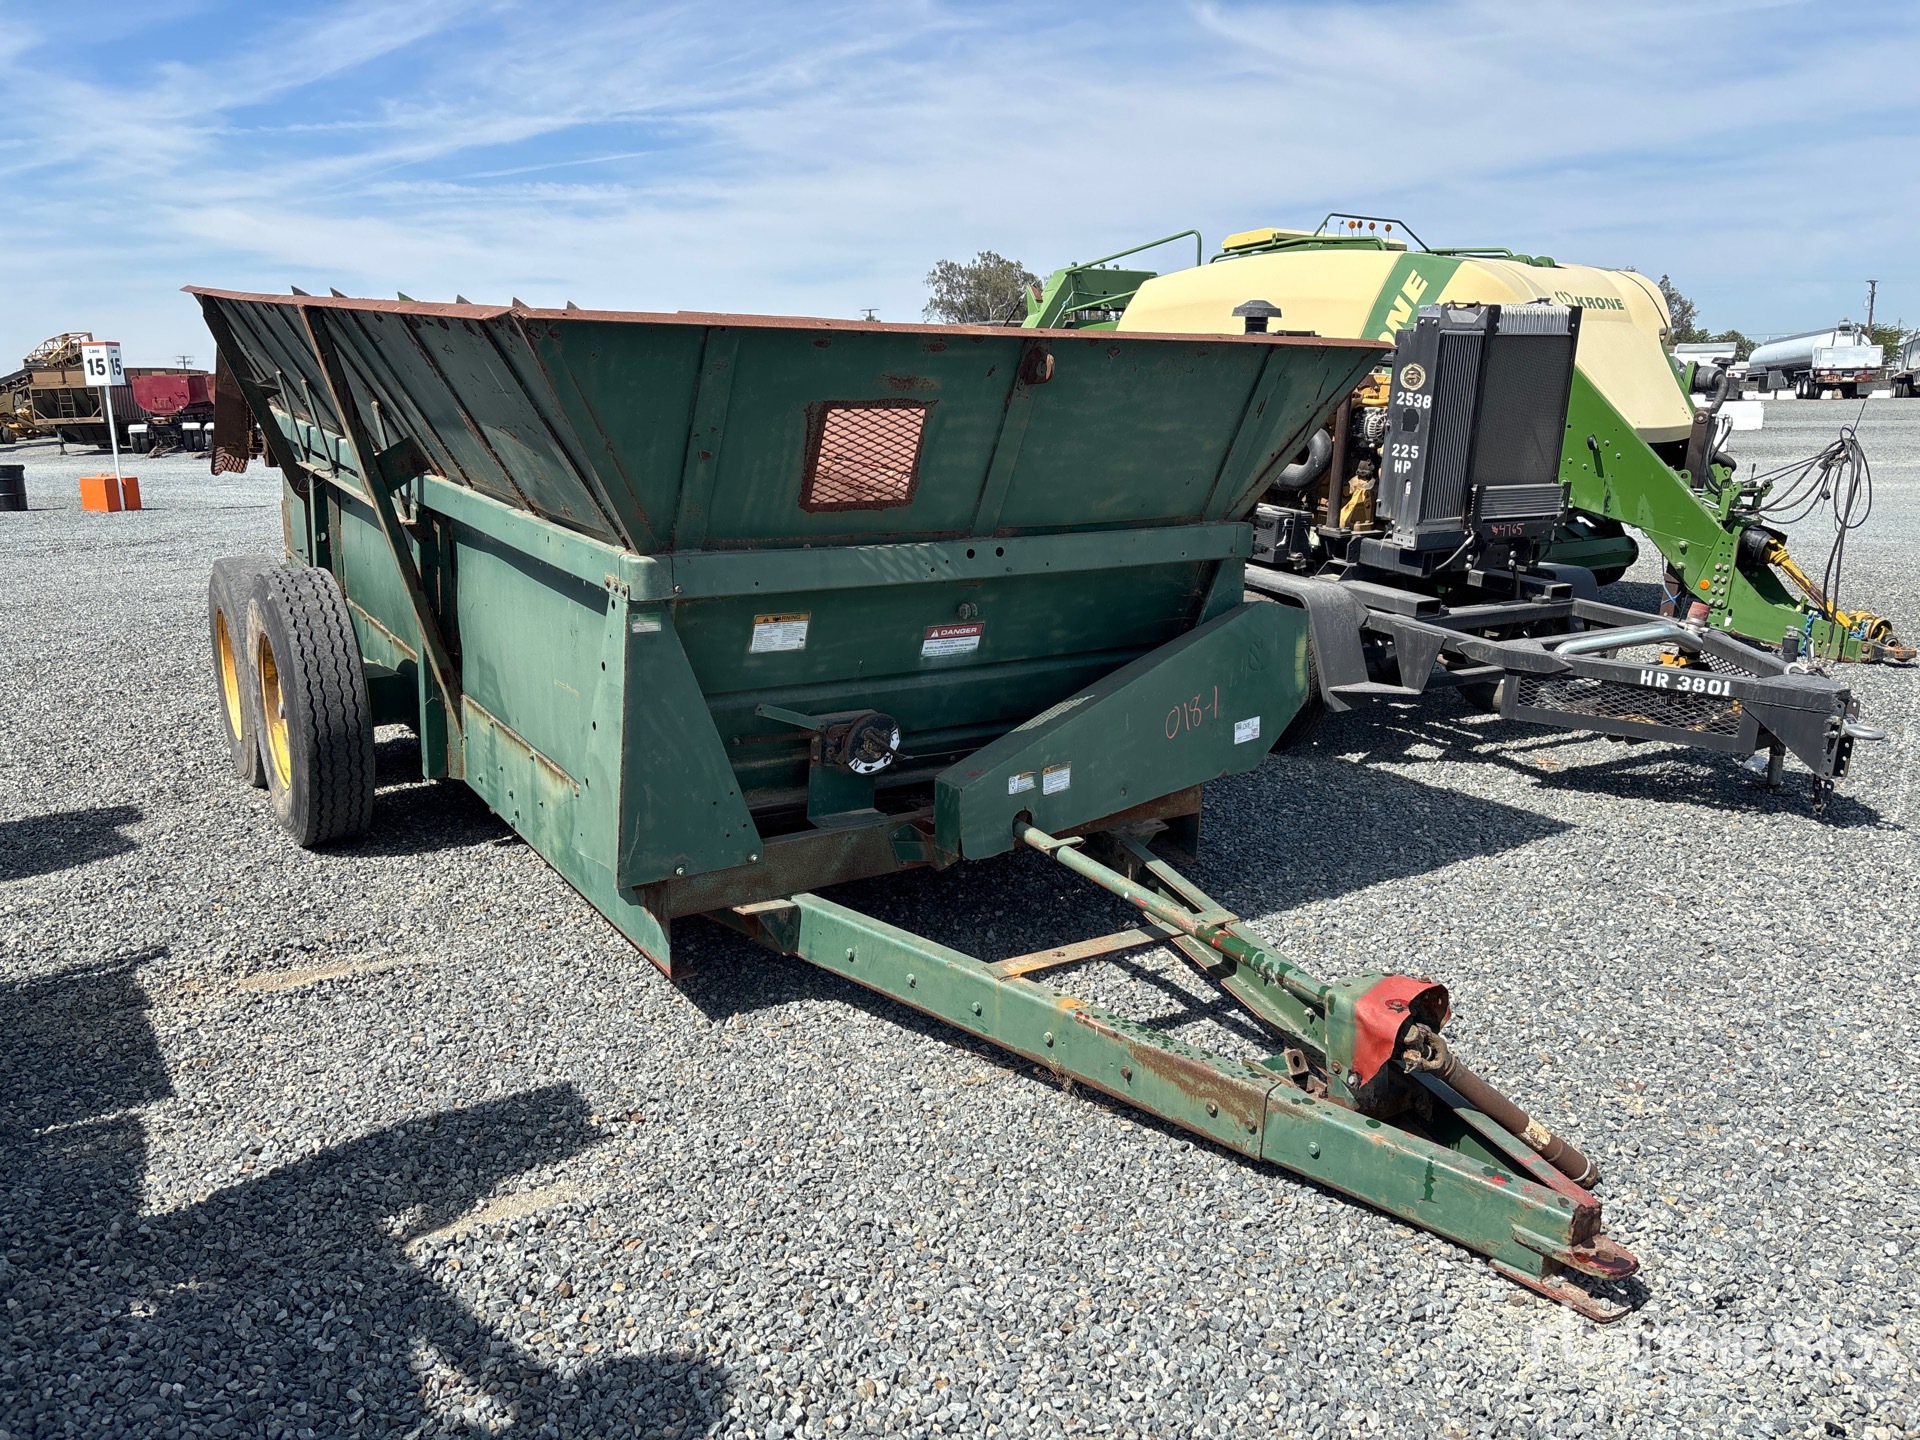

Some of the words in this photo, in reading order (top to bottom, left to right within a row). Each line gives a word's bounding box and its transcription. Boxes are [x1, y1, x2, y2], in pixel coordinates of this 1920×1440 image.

[1574, 296, 1625, 310] KRONE
[87, 357, 106, 376] 15
[110, 357, 122, 376] 15
[1396, 391, 1432, 409] 2538
[1391, 443, 1419, 459] 225
[1394, 459, 1412, 474] HP
[940, 627, 978, 636] DANGER
[1640, 669, 1669, 688] HR
[1676, 675, 1731, 697] 3801
[1165, 685, 1218, 739] 018-1
